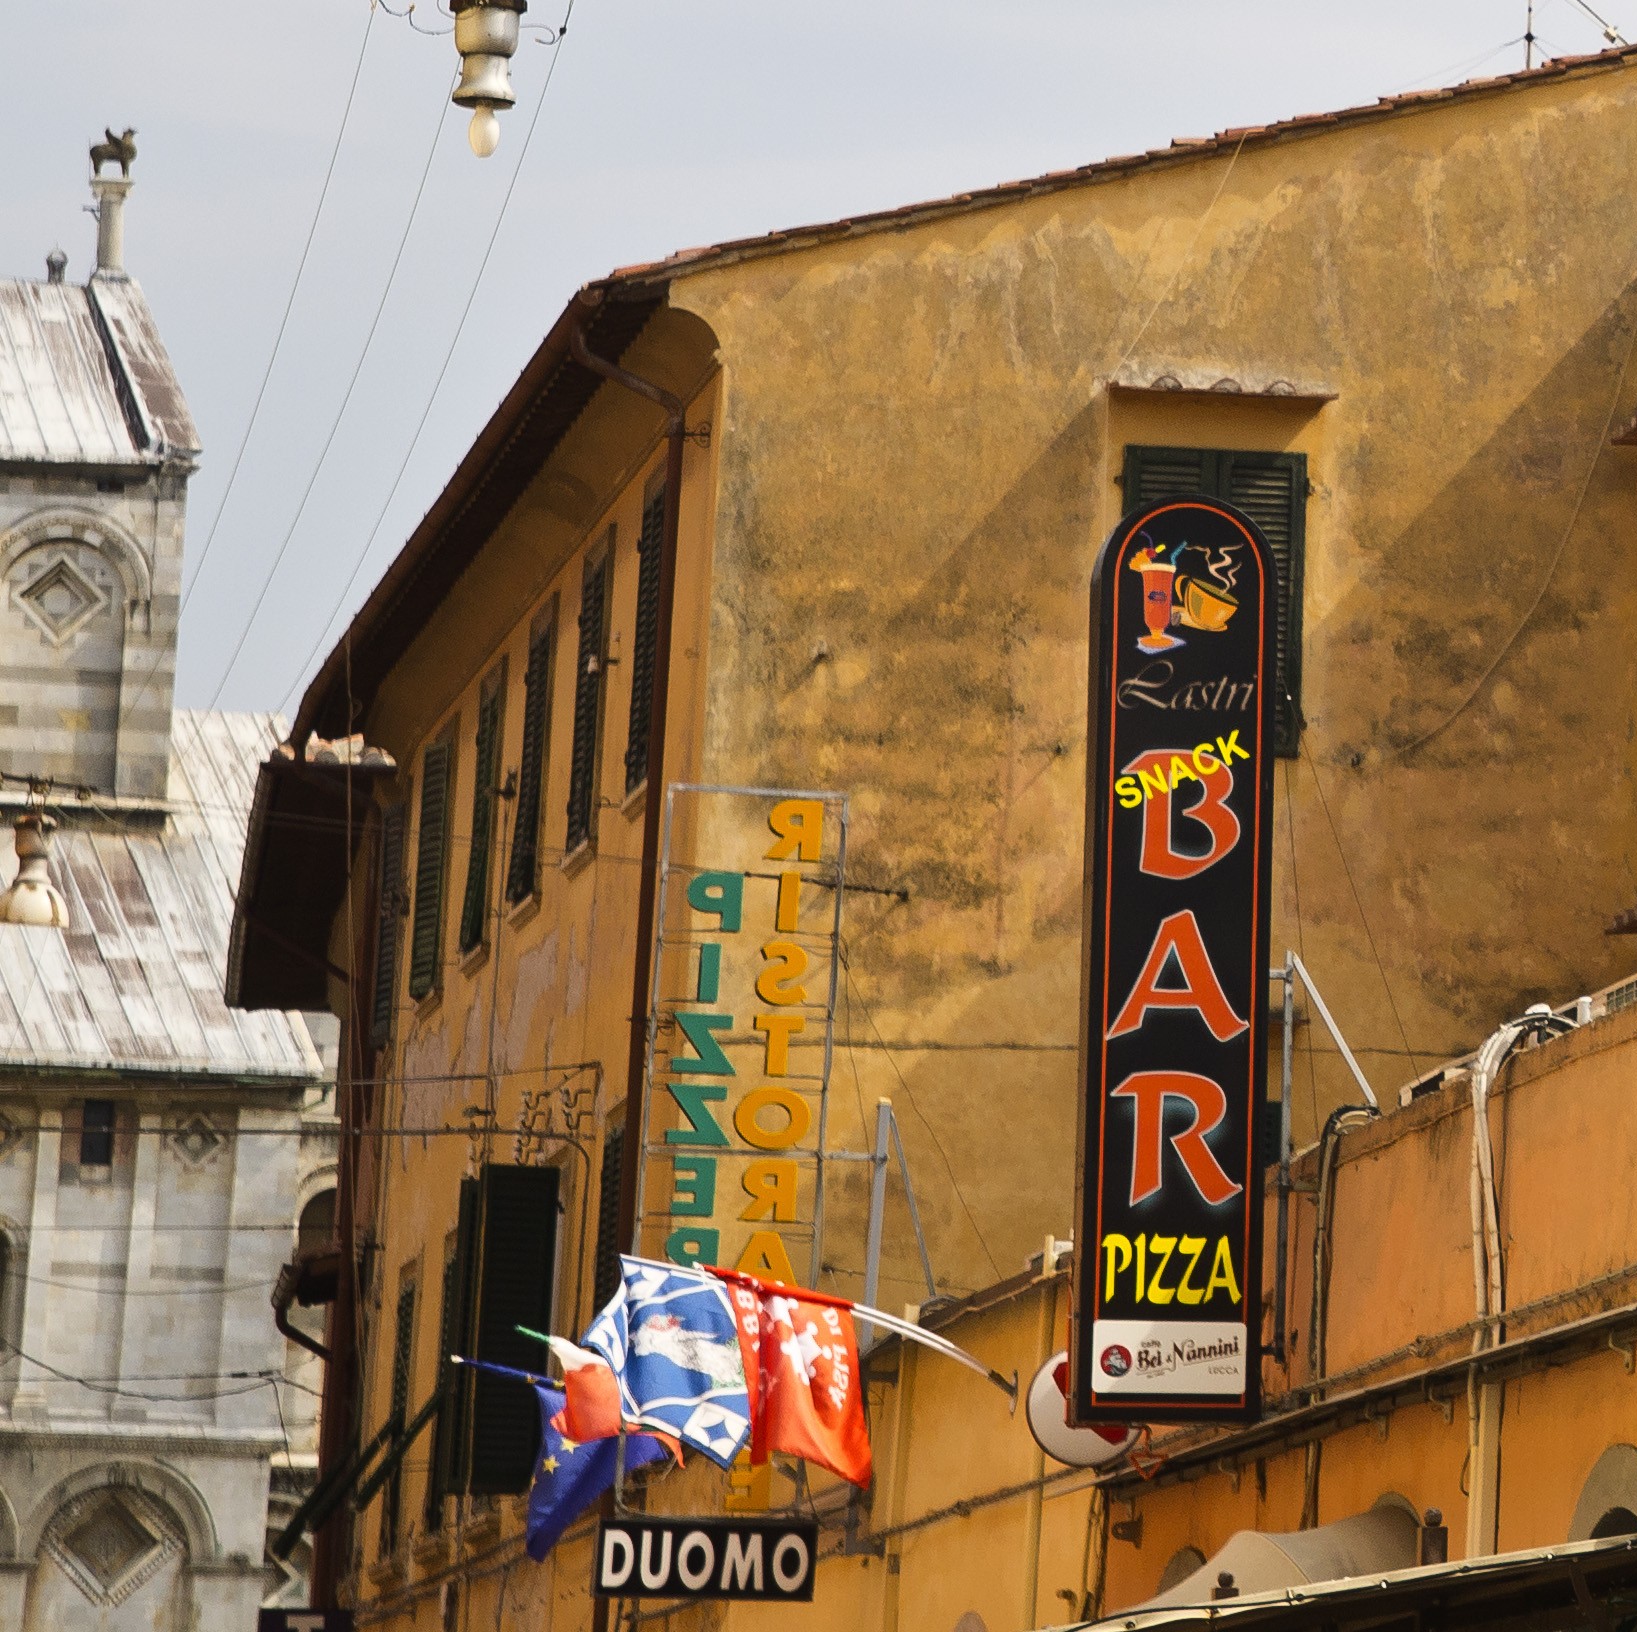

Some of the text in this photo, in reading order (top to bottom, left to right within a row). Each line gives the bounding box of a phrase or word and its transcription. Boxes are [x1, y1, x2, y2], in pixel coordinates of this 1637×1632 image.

[1114, 729, 1250, 808] SNACK
[1105, 749, 1250, 1207] BAR
[1102, 1234, 1241, 1305] PIZZA
[1172, 1335, 1240, 1368] Nannini
[601, 1528, 811, 1592] DUOMO
